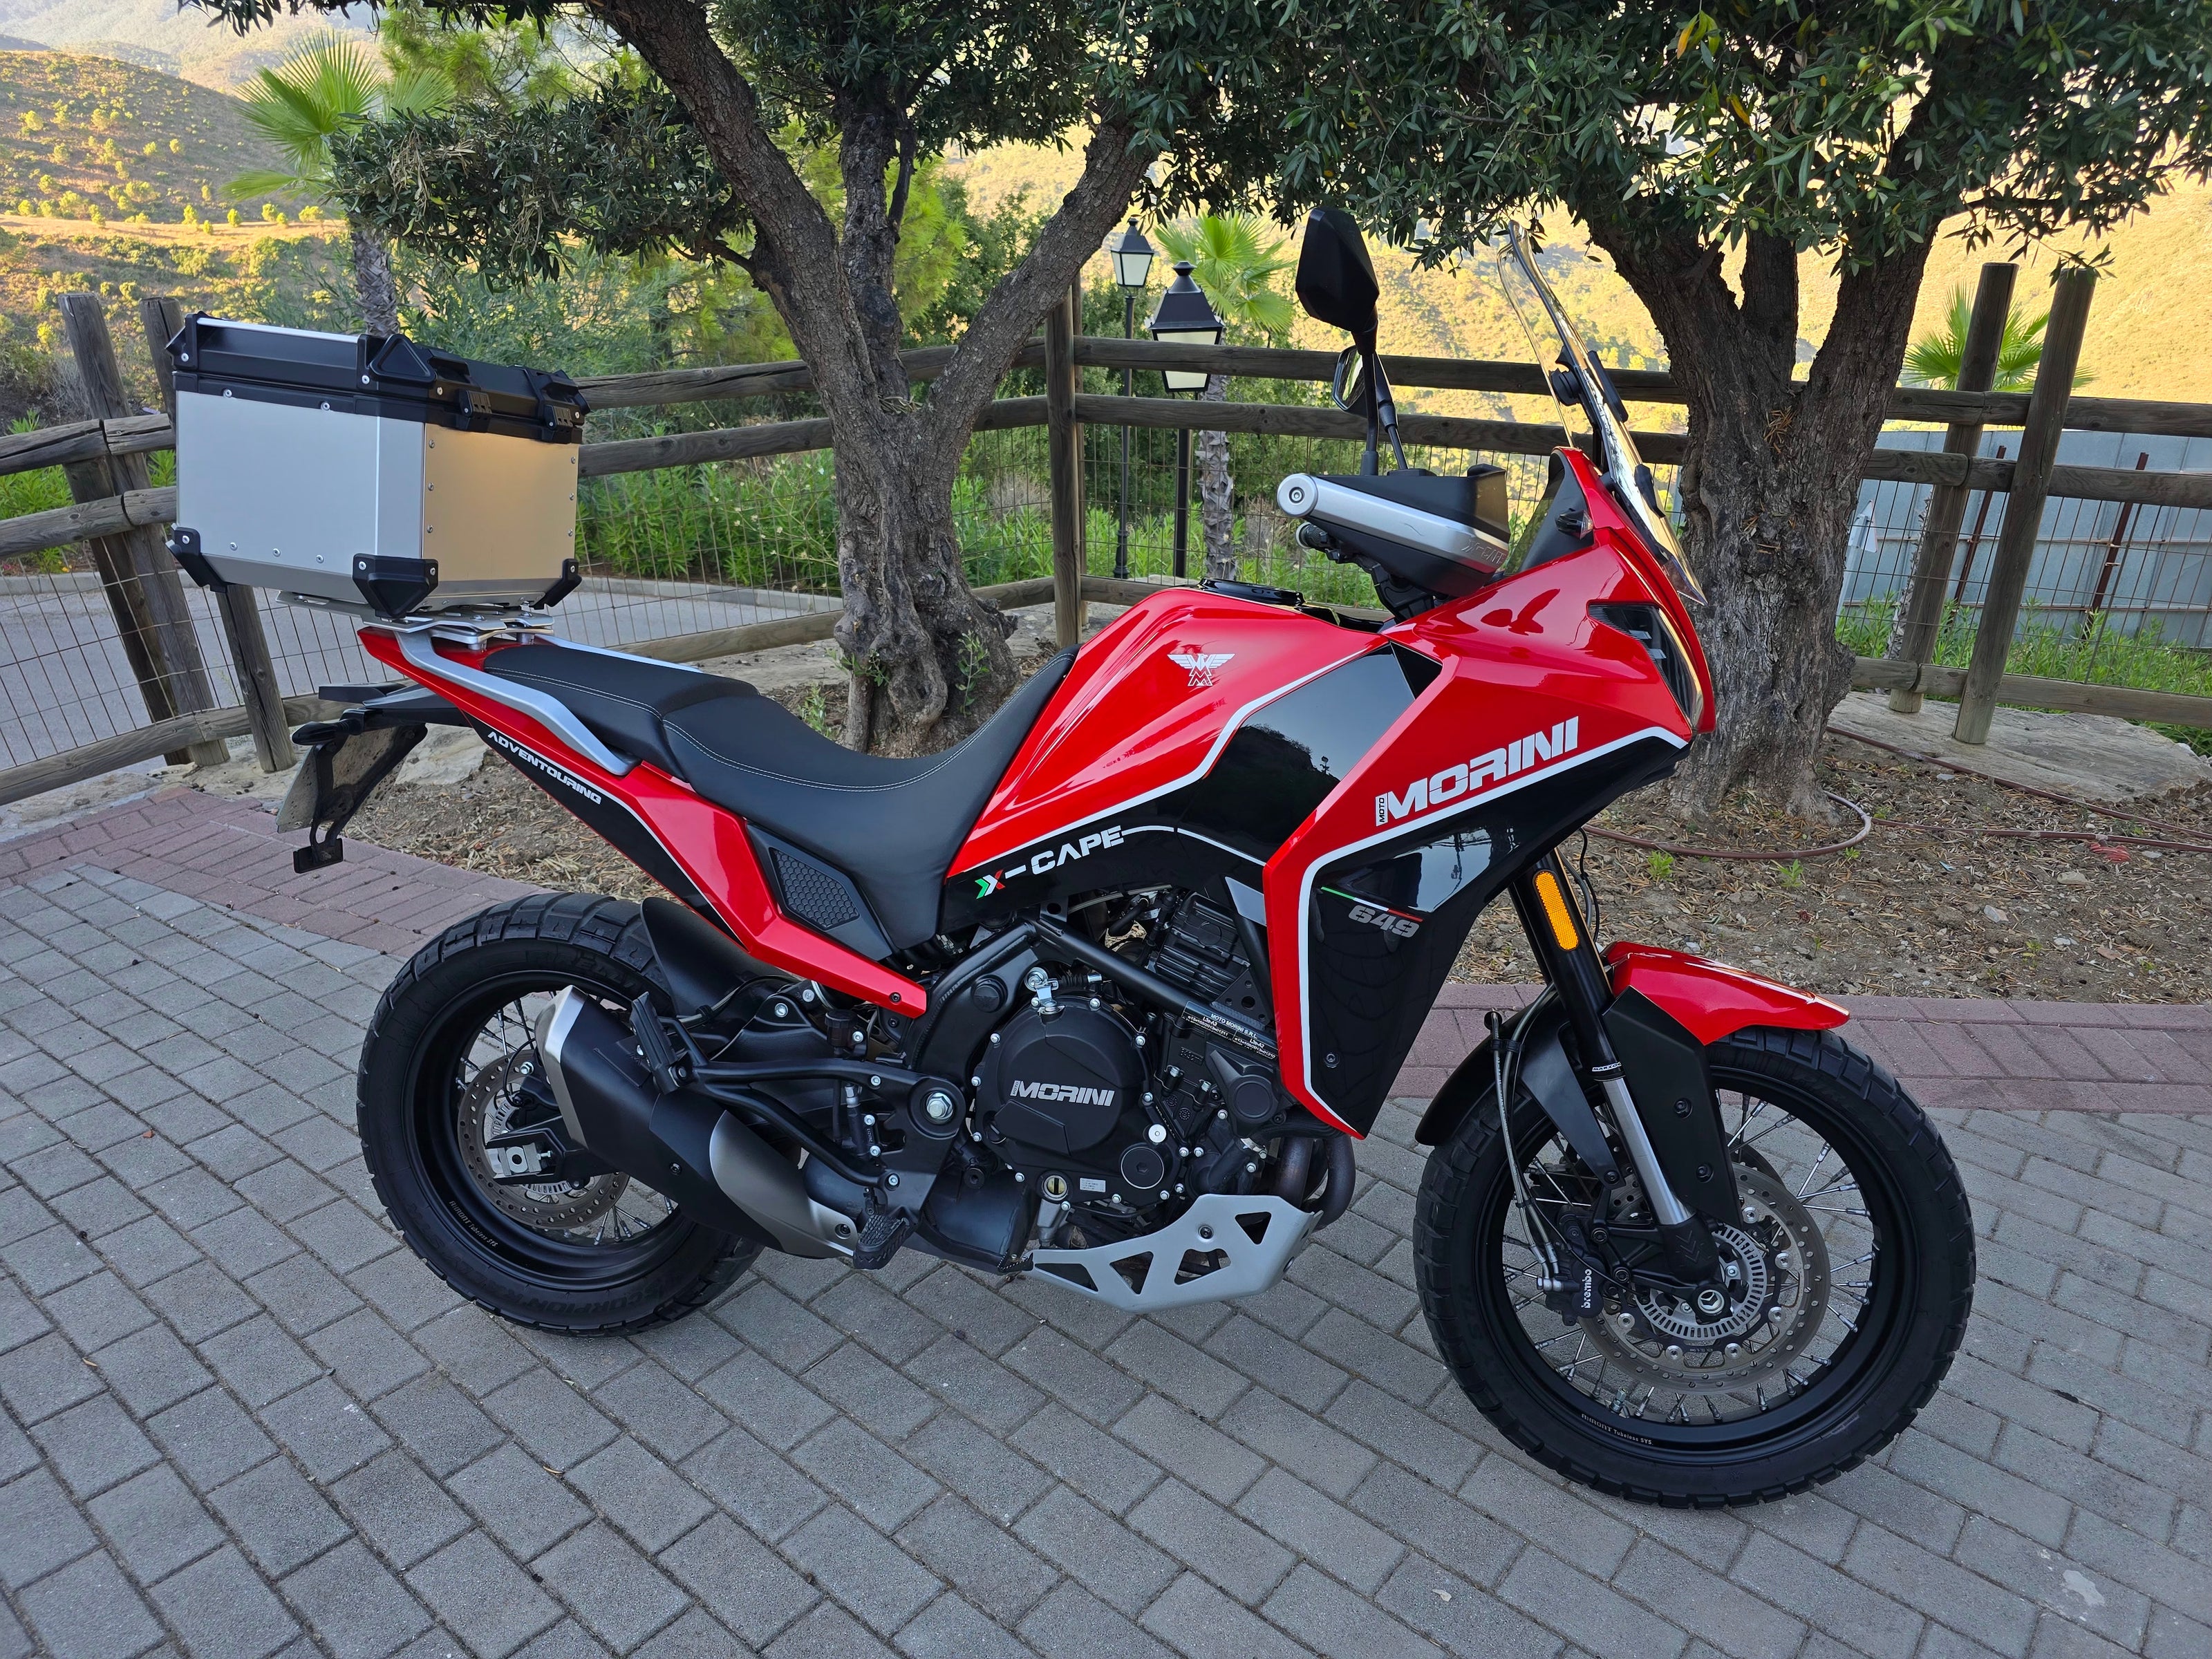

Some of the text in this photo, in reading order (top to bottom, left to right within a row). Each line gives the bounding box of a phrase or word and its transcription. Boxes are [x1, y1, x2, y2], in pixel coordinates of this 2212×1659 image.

[488, 731, 601, 805] ADVENTOURING
[1388, 716, 1579, 820] MORINI
[975, 825, 1124, 899] X-CAPE
[1348, 904, 1420, 938] 649
[1210, 1013, 1226, 1024] MOTO
[1226, 1020, 1244, 1032] MORINI
[1018, 1080, 1115, 1107] MORINI
[1581, 1269, 1592, 1309] brembo
[1613, 1429, 1638, 1442] Tubeless
